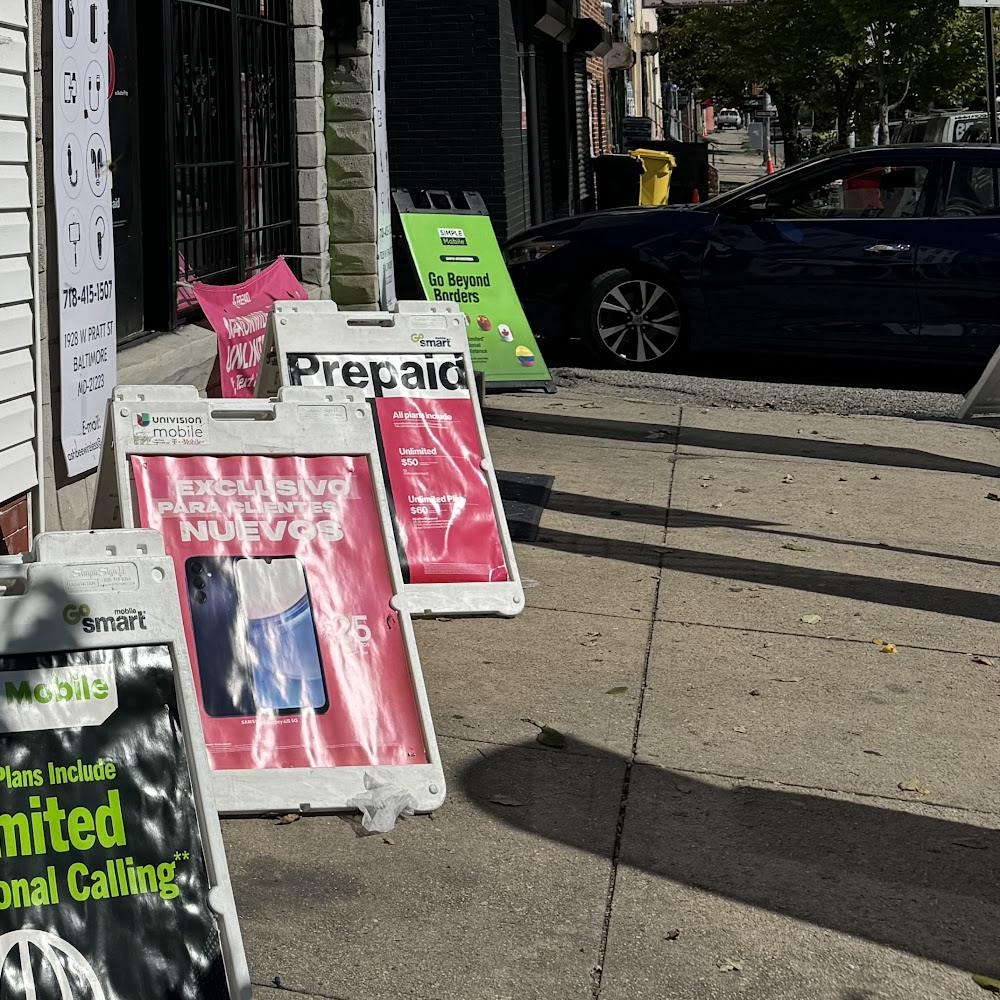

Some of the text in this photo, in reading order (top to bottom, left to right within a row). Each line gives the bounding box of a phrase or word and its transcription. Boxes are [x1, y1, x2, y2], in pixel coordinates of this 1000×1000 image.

[439, 229, 463, 237] SIMPLE
[428, 272, 490, 290] Go Beyond
[63, 280, 112, 309] 718-415-1507
[434, 288, 480, 303] Borders
[64, 320, 114, 348] 1928 W PRATT ST
[420, 338, 452, 348] smart
[73, 347, 108, 372] BALTIMORE
[286, 353, 469, 397] Prepaid
[77, 373, 105, 397] MD-21223
[152, 416, 202, 424] univision
[392, 411, 404, 419] All
[425, 411, 452, 421] include
[153, 425, 203, 438] mobile
[398, 448, 437, 456] Unlimited
[401, 458, 419, 467] $50
[176, 478, 351, 498] EXCLUSIVO
[157, 500, 339, 515] PARA CLIENTES
[410, 506, 428, 515] $60
[180, 519, 344, 542] NUEVOS
[114, 607, 137, 615] mobile
[81, 610, 147, 634] smart
[5, 674, 109, 705] Mobile
[48, 759, 117, 784] Include
